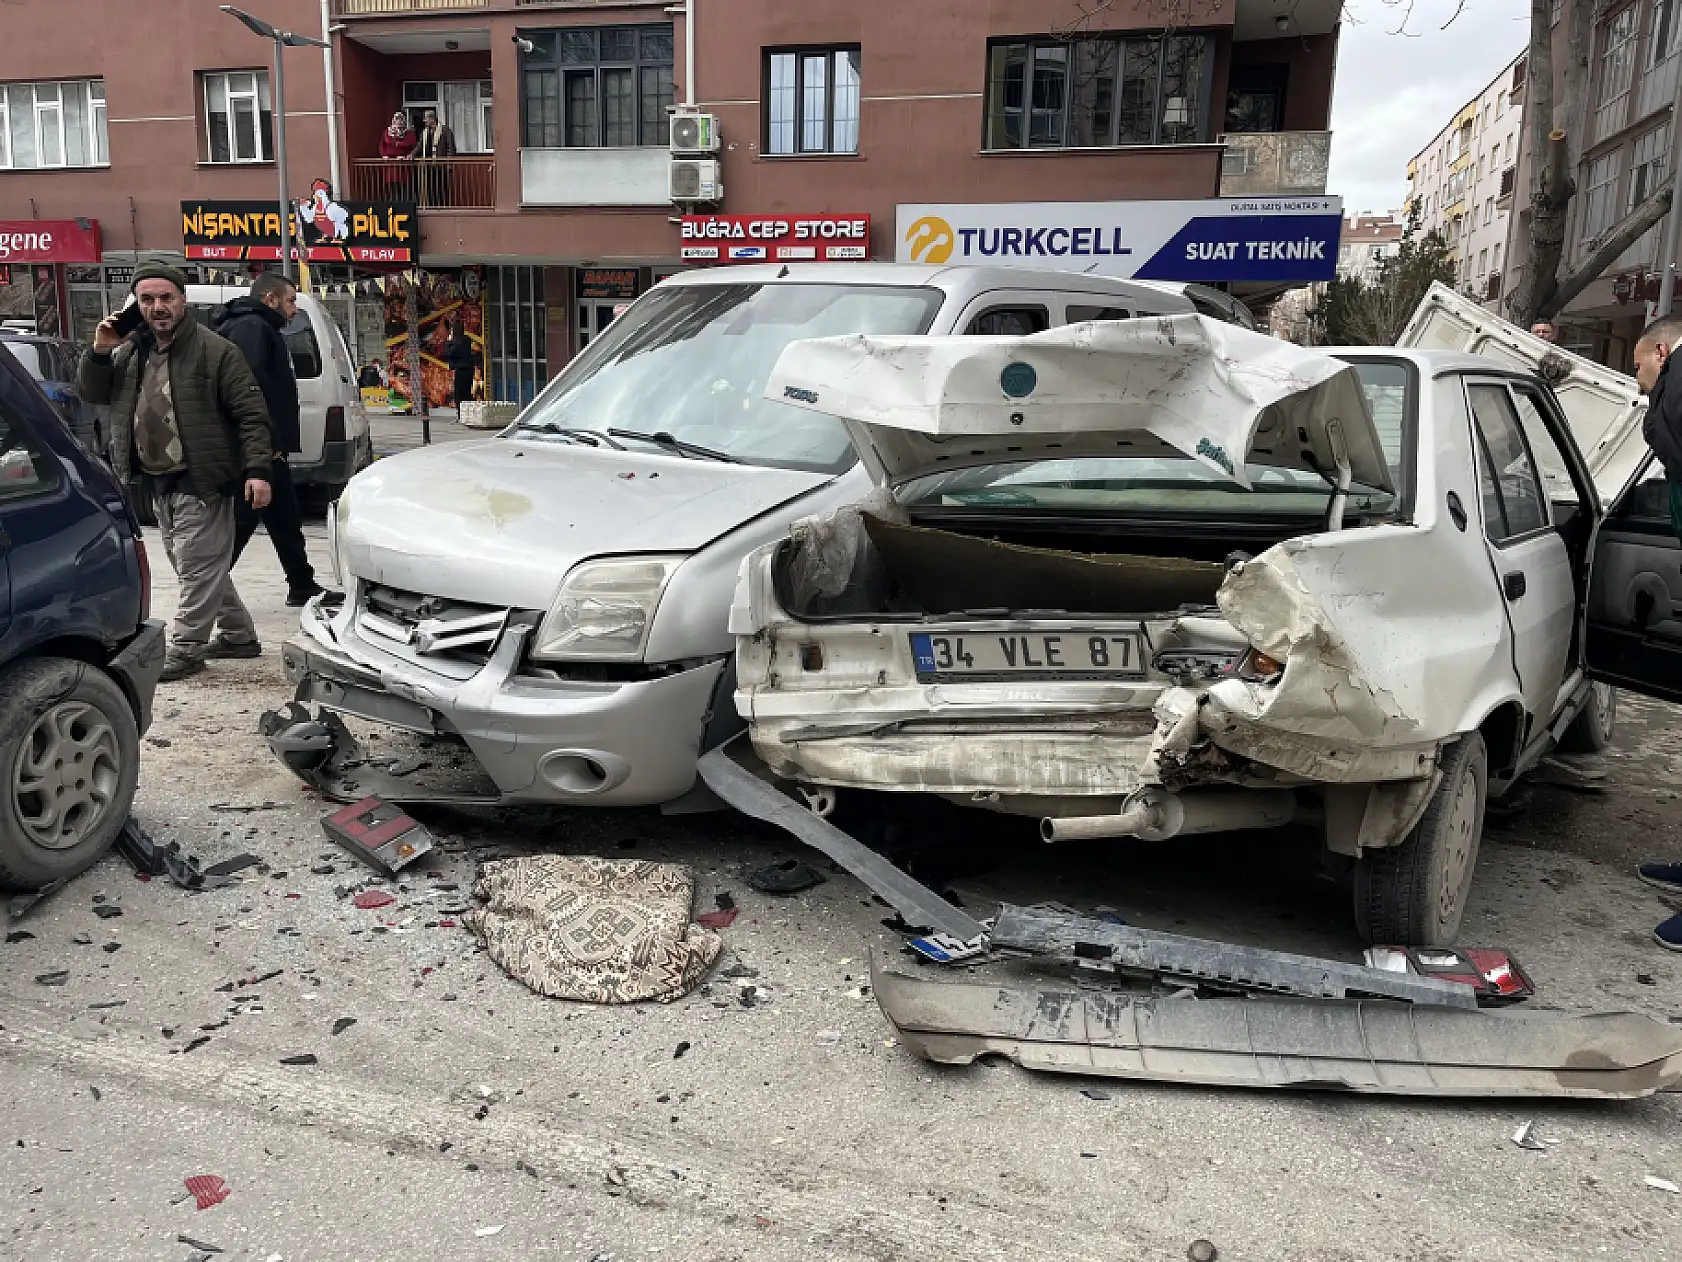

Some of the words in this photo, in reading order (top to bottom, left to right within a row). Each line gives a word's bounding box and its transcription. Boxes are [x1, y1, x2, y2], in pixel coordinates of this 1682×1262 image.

[353, 206, 410, 242] PİLİÇ
[682, 216, 746, 238] BUĞRA
[748, 220, 790, 238] CEP
[794, 220, 866, 238] STORE
[201, 247, 227, 257] BUT
[957, 226, 1133, 257] TURKCELL
[1185, 242, 1240, 260] SUAT
[1245, 236, 1326, 260] TEKNİK
[932, 636, 975, 668] 34
[998, 636, 1066, 668] VLE
[1088, 637, 1132, 668] 87
